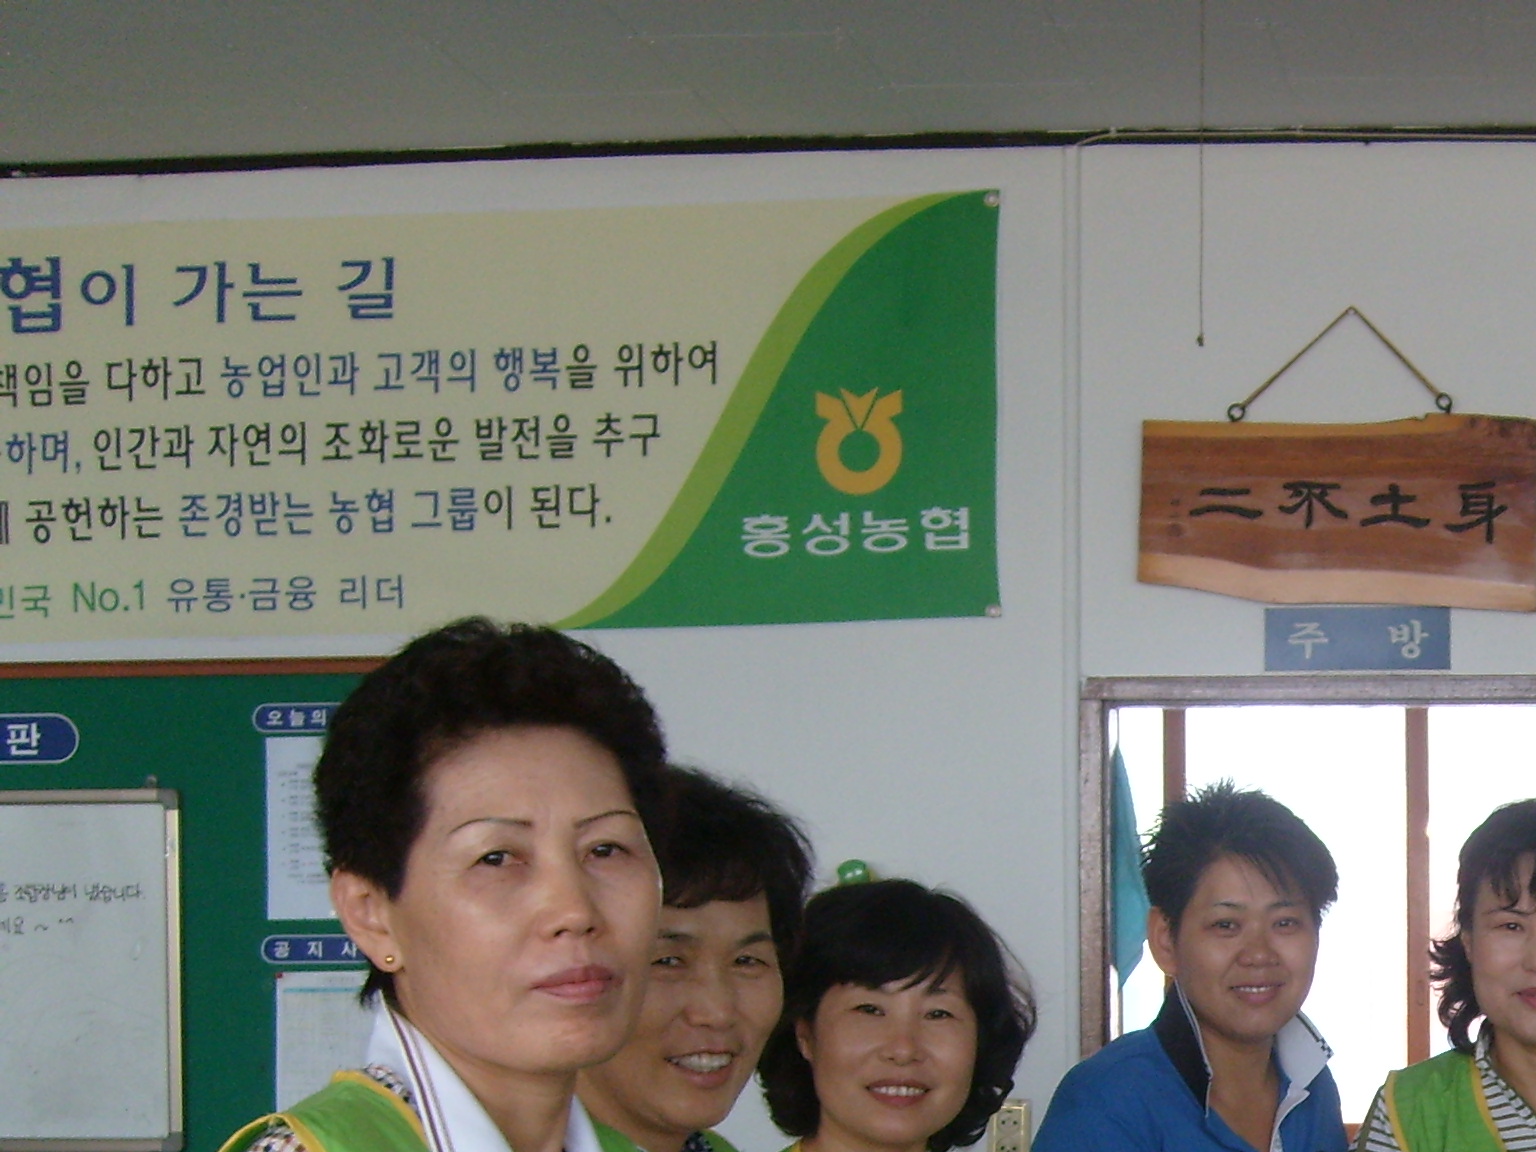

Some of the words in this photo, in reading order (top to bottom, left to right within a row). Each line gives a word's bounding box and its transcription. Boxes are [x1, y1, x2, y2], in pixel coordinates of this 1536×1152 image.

[0, 256, 135, 333] 협이
[172, 261, 303, 323] 가는
[337, 256, 397, 320] 길
[106, 356, 206, 402] 다하고
[220, 351, 360, 399] 농업인과
[373, 349, 477, 395] 고객의
[494, 343, 598, 393] 행복을
[613, 340, 719, 388] 위하여
[5, 430, 82, 475] 하며,
[93, 424, 195, 471] 인간과
[208, 421, 307, 468] 자연의
[322, 417, 460, 464] 조화로운
[474, 413, 578, 461] 발전을
[592, 412, 661, 457] 추구
[25, 495, 163, 545] 공헌하는
[179, 491, 314, 538] 존경받는
[328, 488, 394, 535] 농협
[411, 485, 513, 532] 그룹이
[530, 483, 612, 530] 된다.
[740, 506, 970, 558] 홍성농협
[73, 579, 145, 614] No.1
[339, 574, 404, 610] 리더
[7, 722, 41, 756] 판
[266, 709, 327, 727] 오늘의
